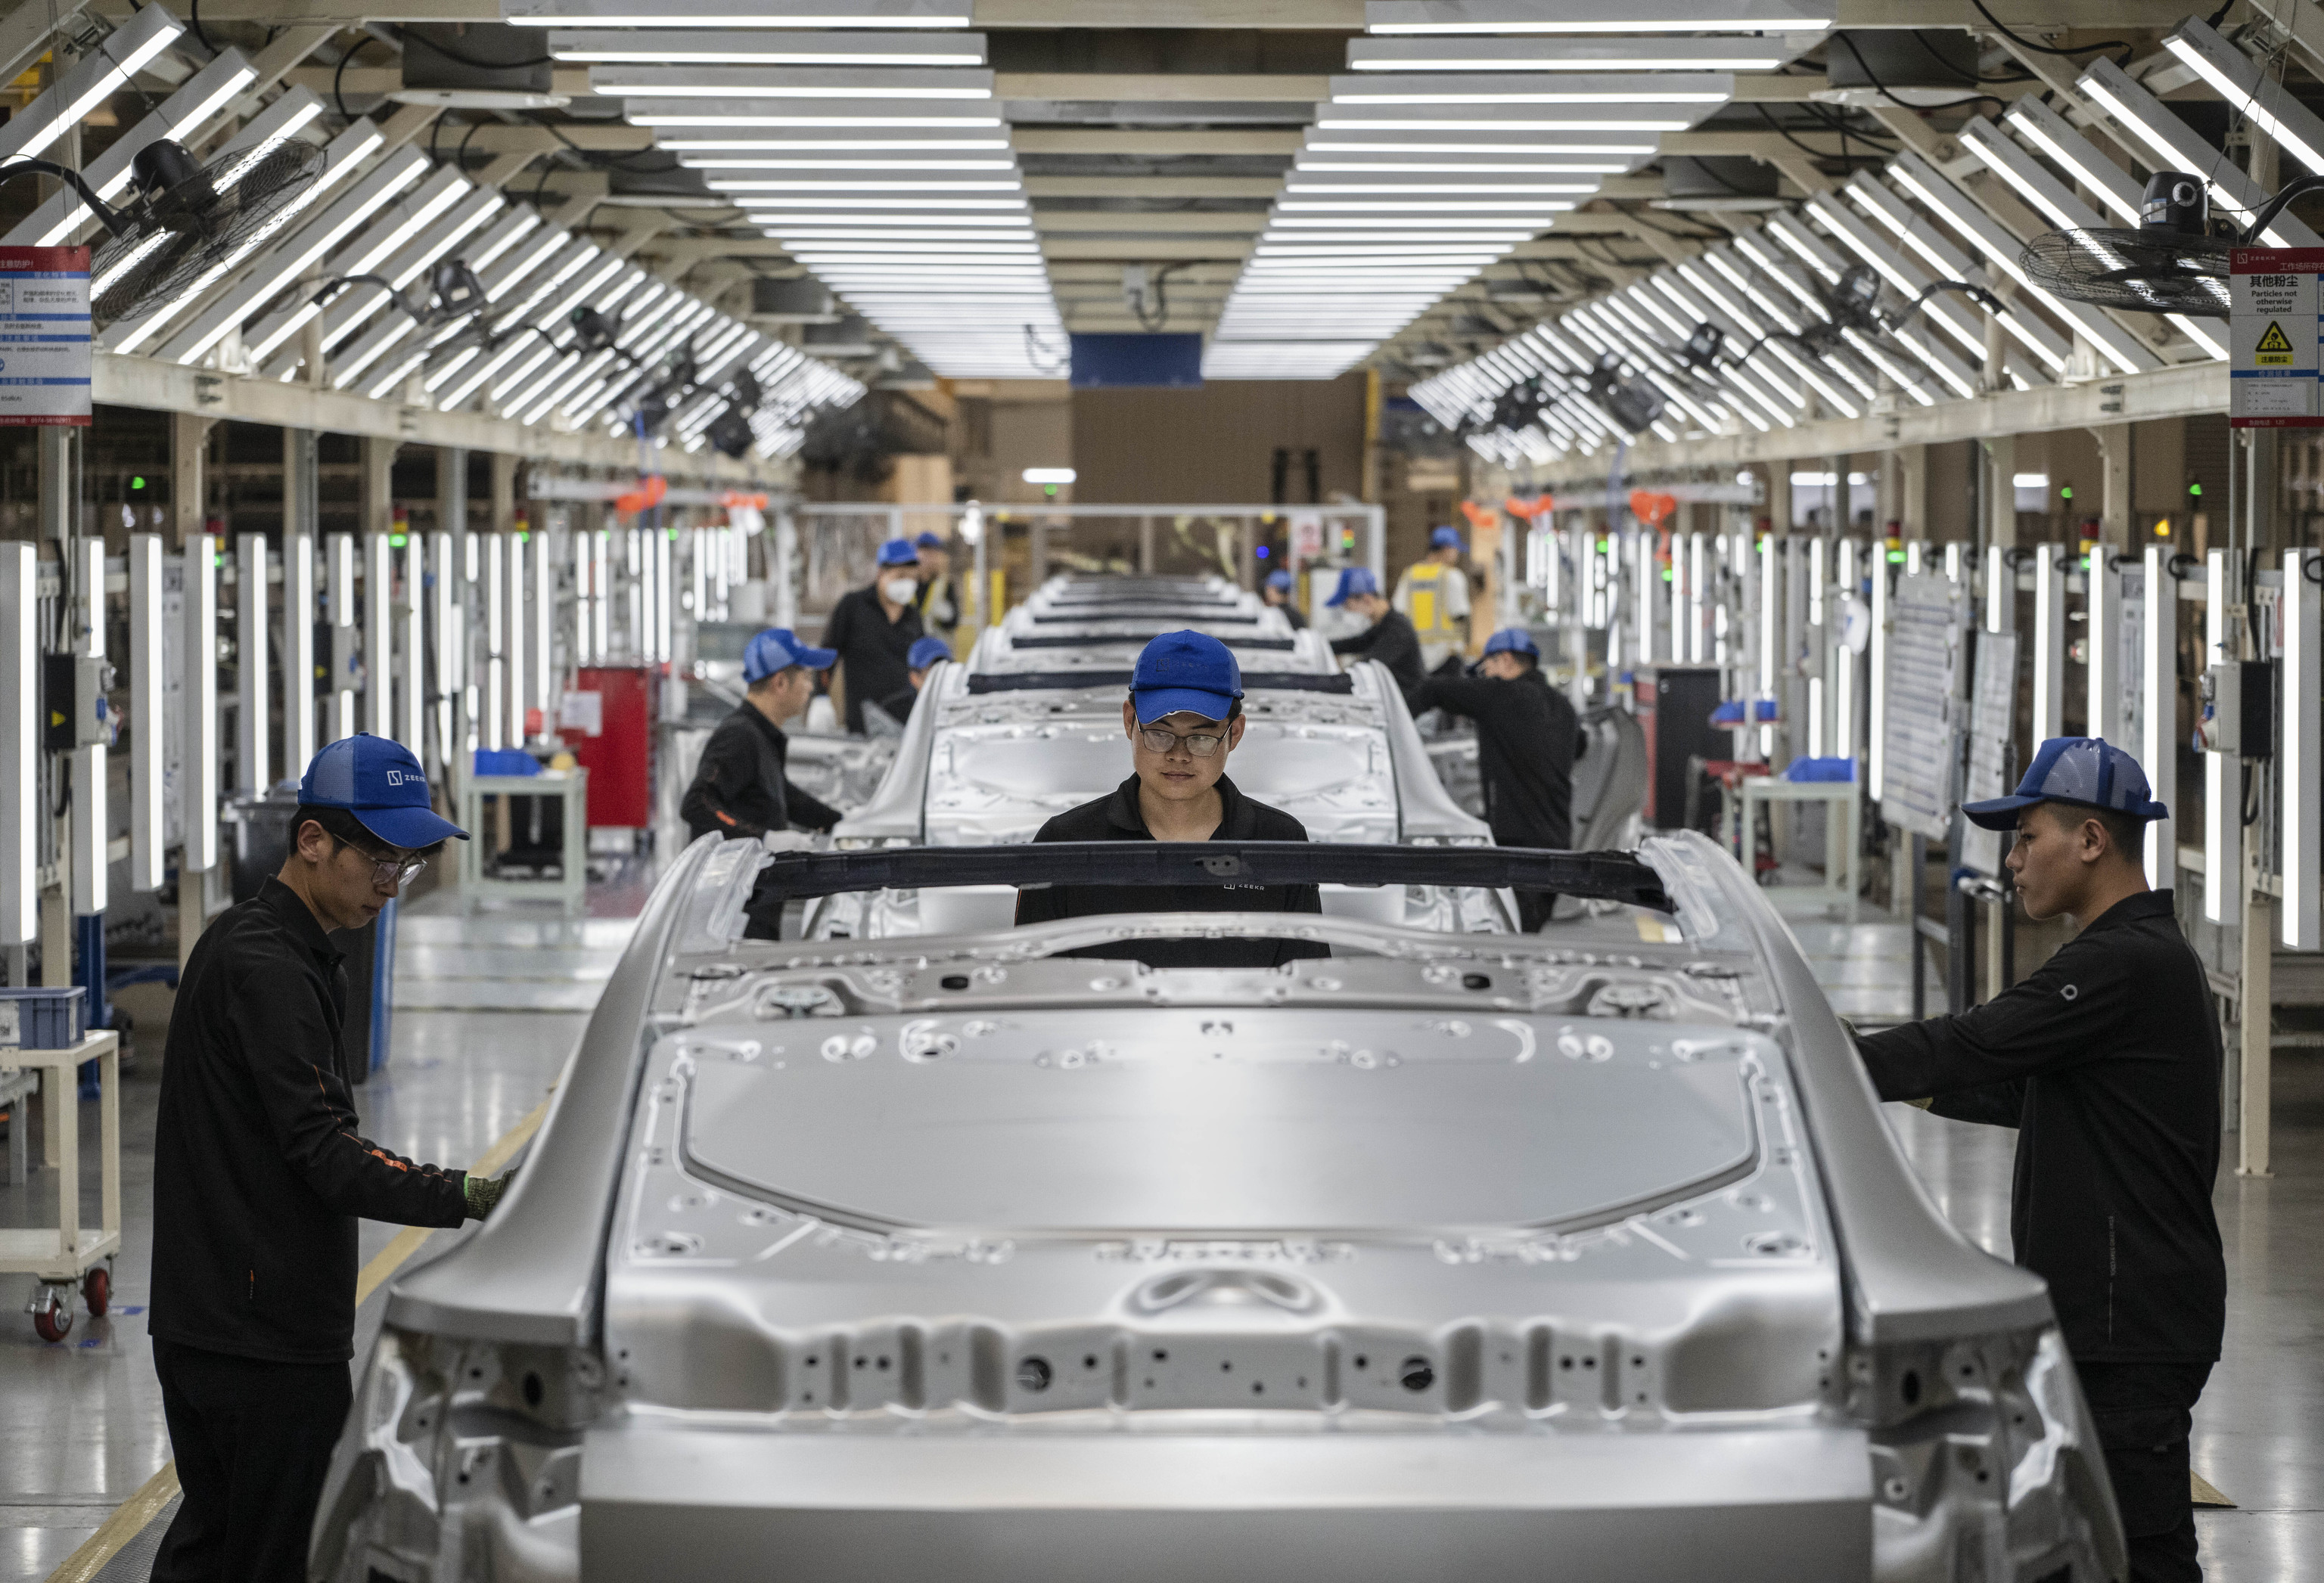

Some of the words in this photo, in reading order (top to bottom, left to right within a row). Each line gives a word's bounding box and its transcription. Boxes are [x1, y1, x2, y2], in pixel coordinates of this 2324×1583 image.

[2250, 275, 2298, 287] 其他粉尘
[2257, 306, 2292, 315] regulated
